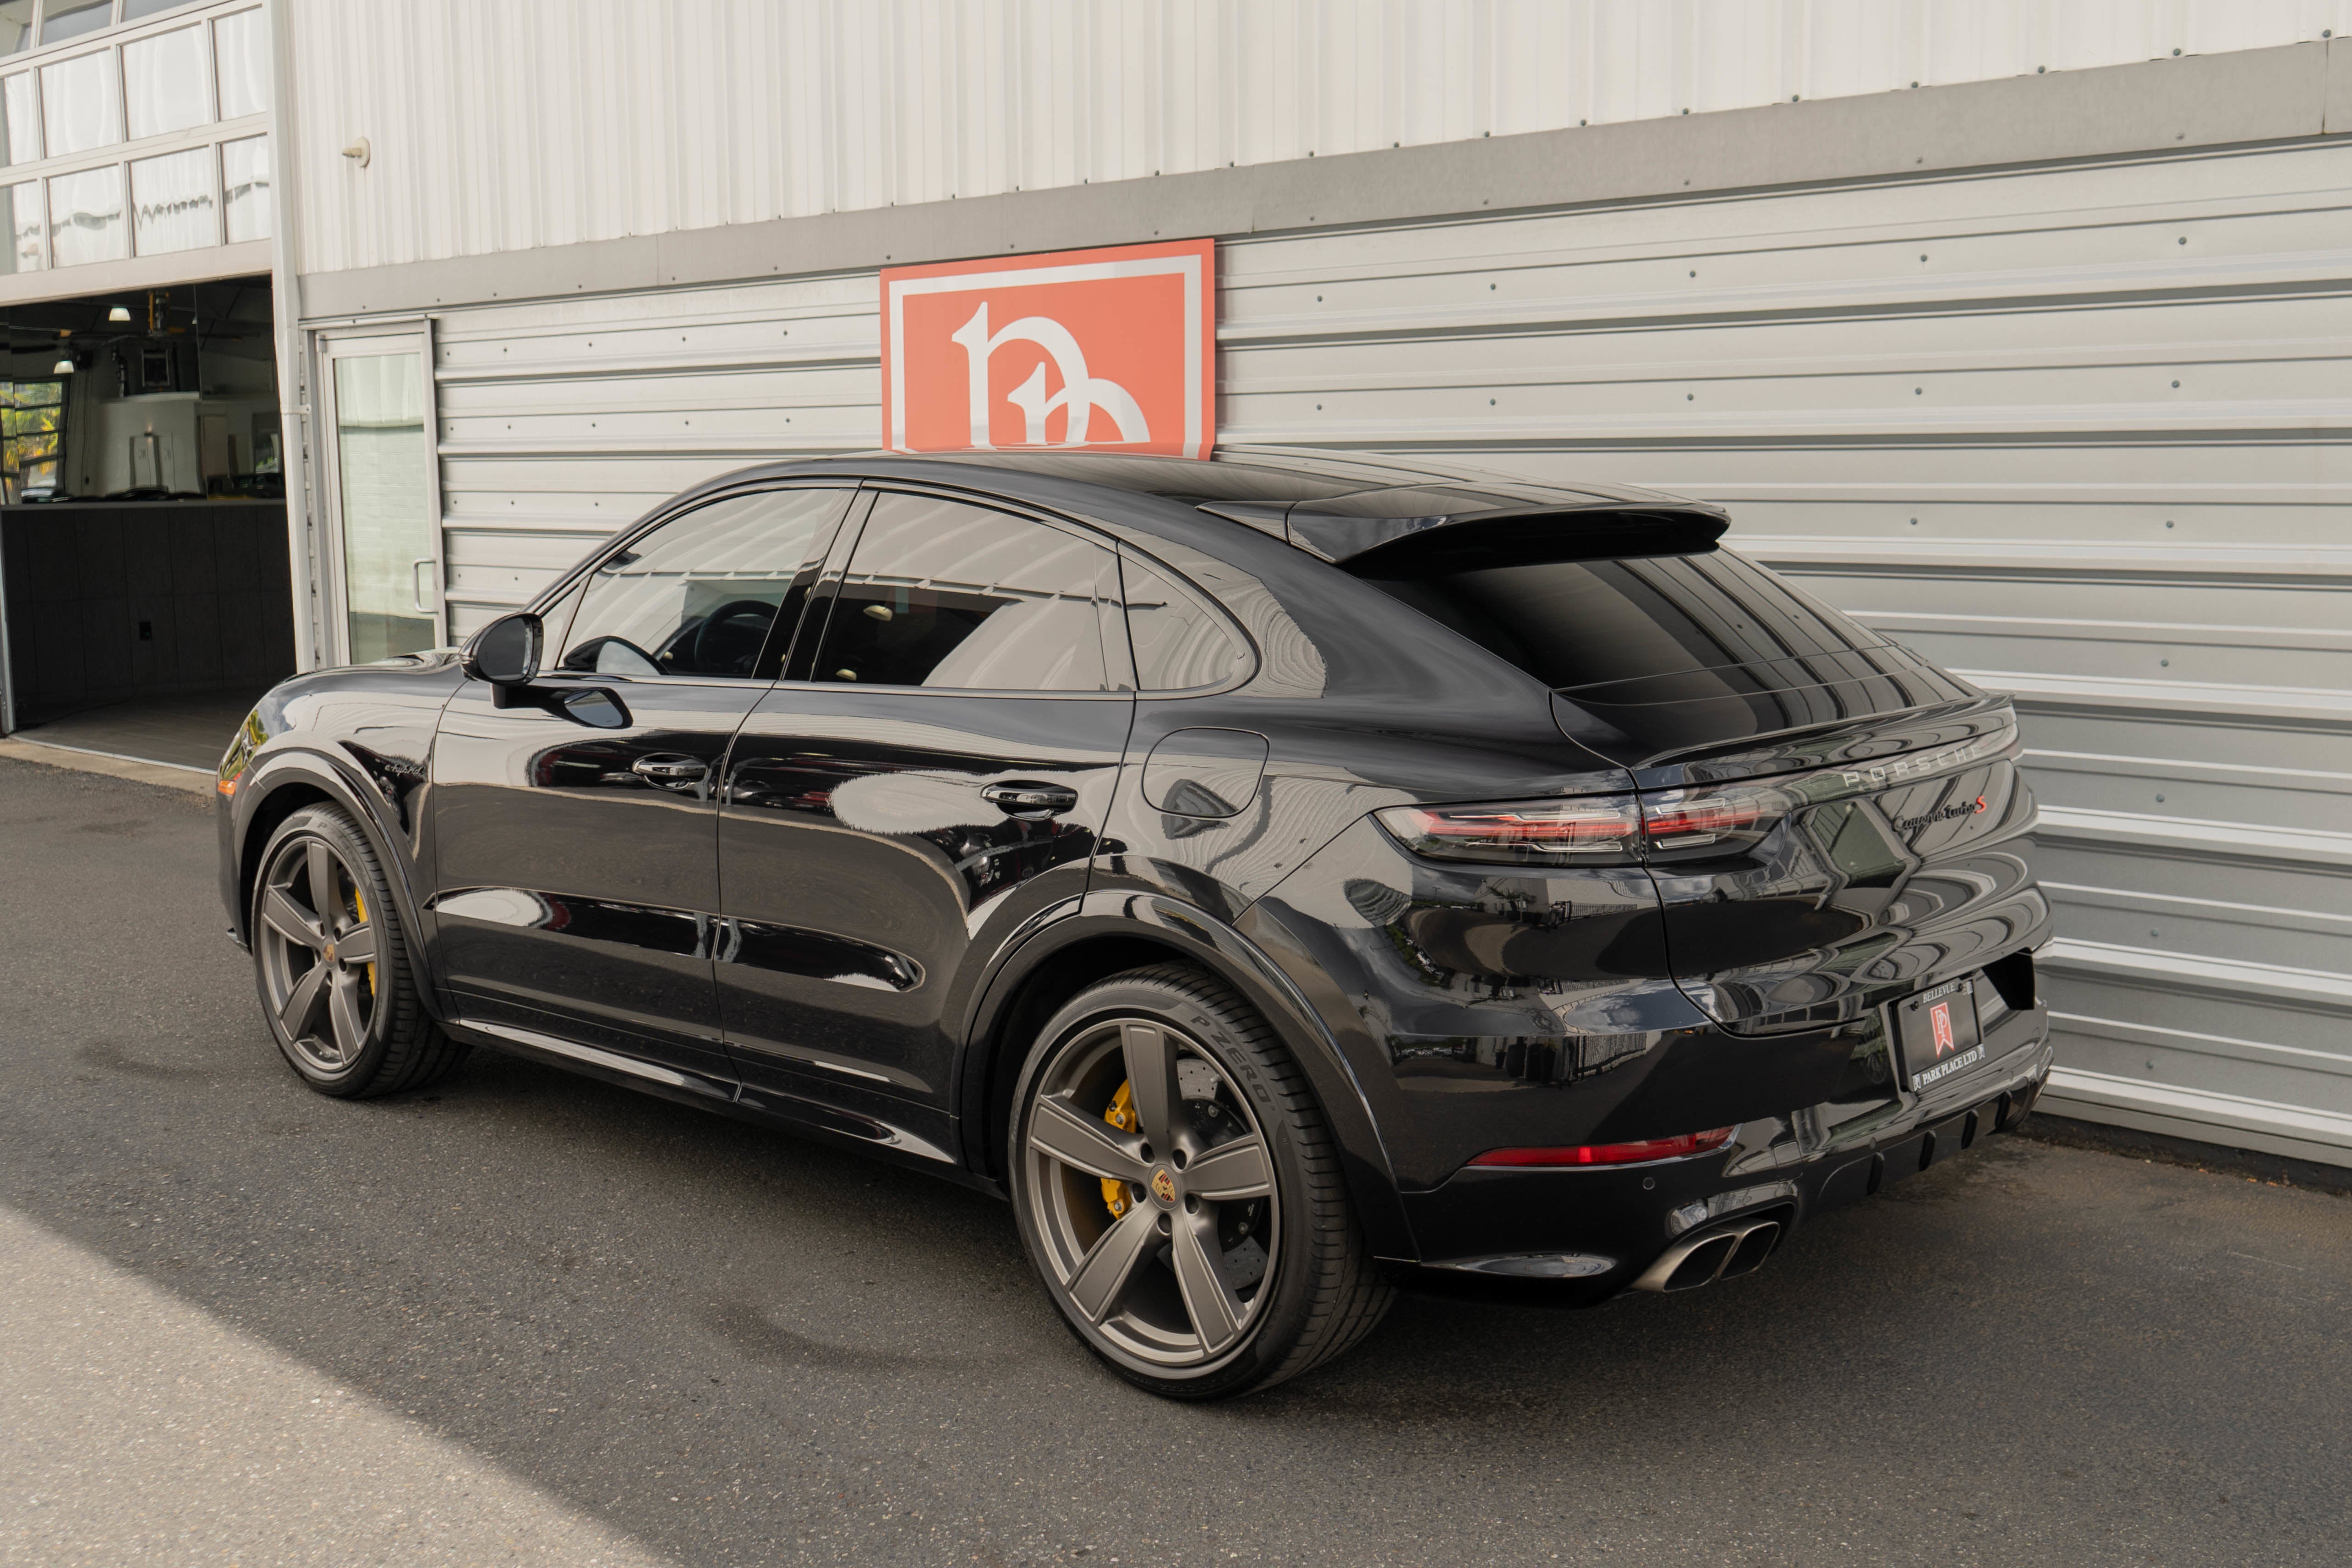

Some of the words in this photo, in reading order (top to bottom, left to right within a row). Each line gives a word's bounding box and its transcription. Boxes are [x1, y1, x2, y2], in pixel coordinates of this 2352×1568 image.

[1892, 812, 1944, 834] Cayenne
[1975, 796, 1986, 813] S
[1923, 982, 1955, 1004] BELLEVUE
[1922, 1067, 1942, 1085] PARK
[1941, 1056, 1963, 1076] PLACE
[1963, 1050, 1977, 1066] LTD
